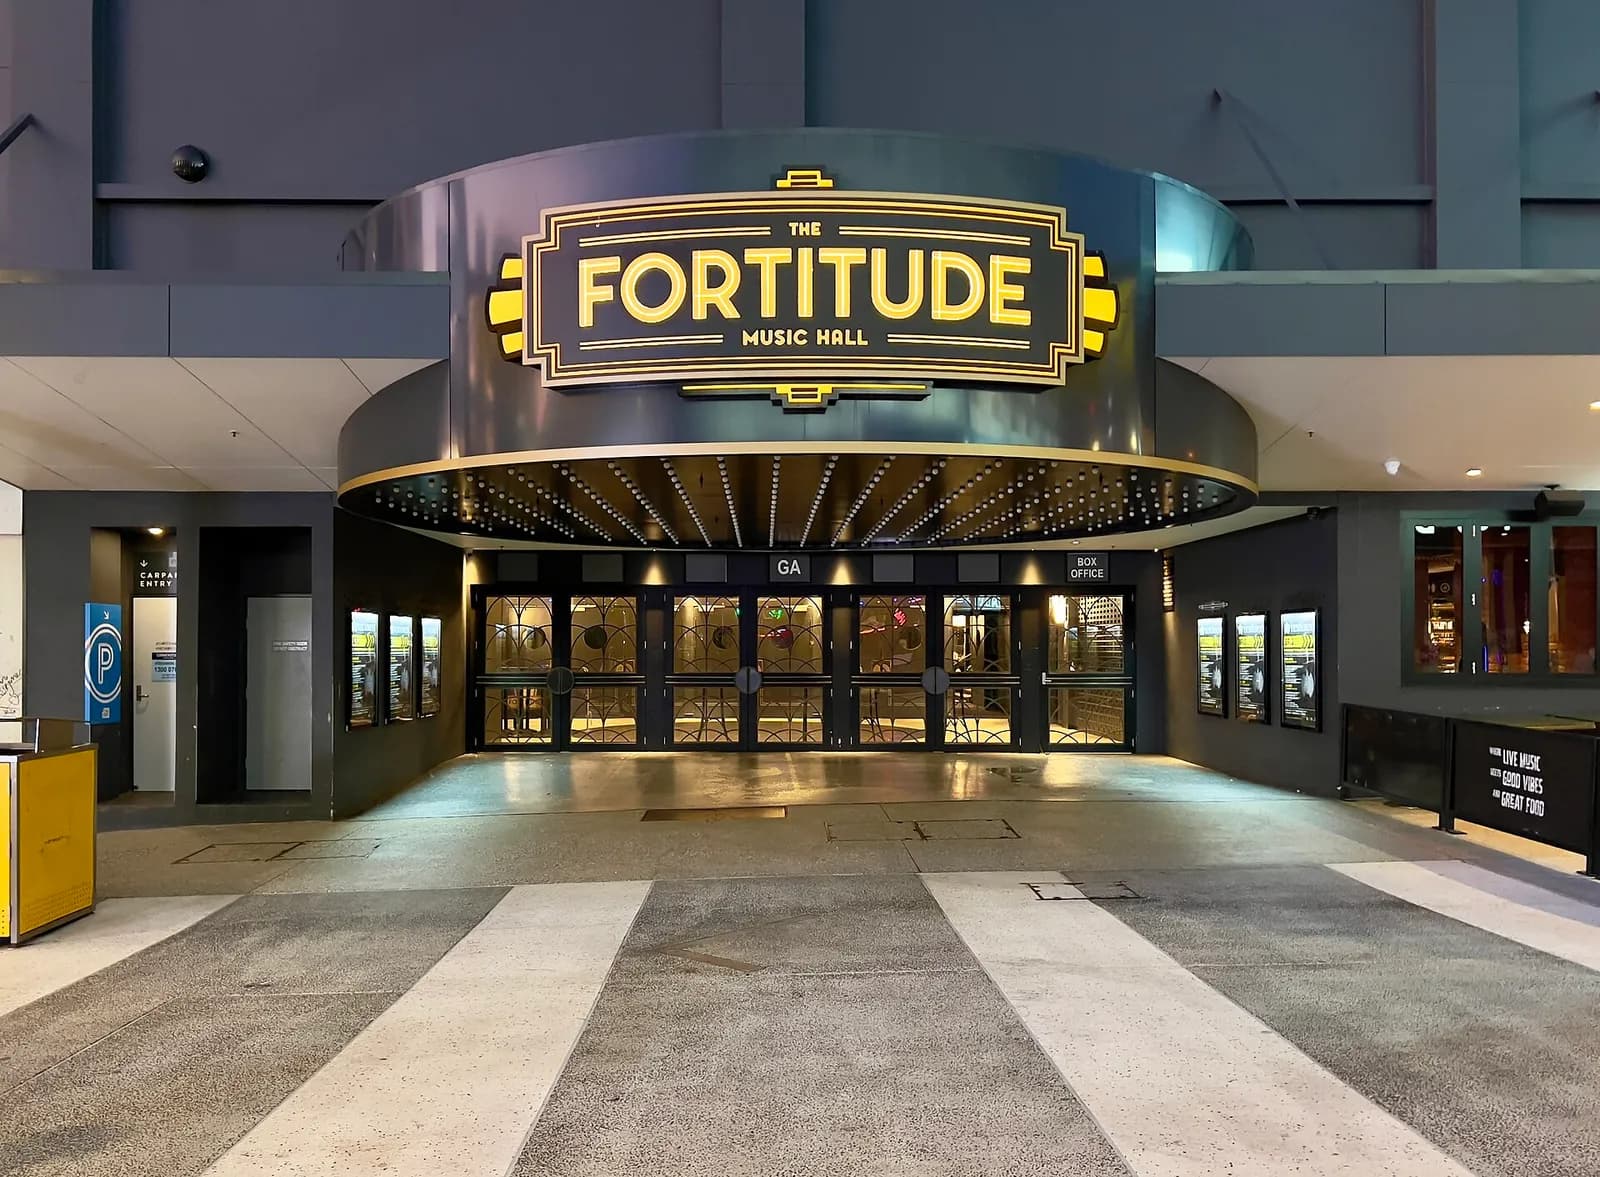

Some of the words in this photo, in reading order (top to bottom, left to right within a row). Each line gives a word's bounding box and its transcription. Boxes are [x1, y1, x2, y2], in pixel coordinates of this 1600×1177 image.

[788, 222, 821, 236] THE
[579, 247, 1032, 327] FORTITUDE
[742, 328, 808, 346] MUSIC
[816, 329, 868, 346] HALL
[777, 559, 801, 575] GA
[1077, 557, 1097, 567] BOX
[1070, 568, 1104, 578] OFFICE
[98, 642, 114, 685] P
[1502, 748, 1518, 767] LIVE
[1519, 752, 1541, 772] MUSIC
[1502, 770, 1521, 789] GOOD
[1522, 774, 1544, 794] VIBES
[1501, 791, 1524, 811] GREAT
[1525, 797, 1545, 817] FOOD
